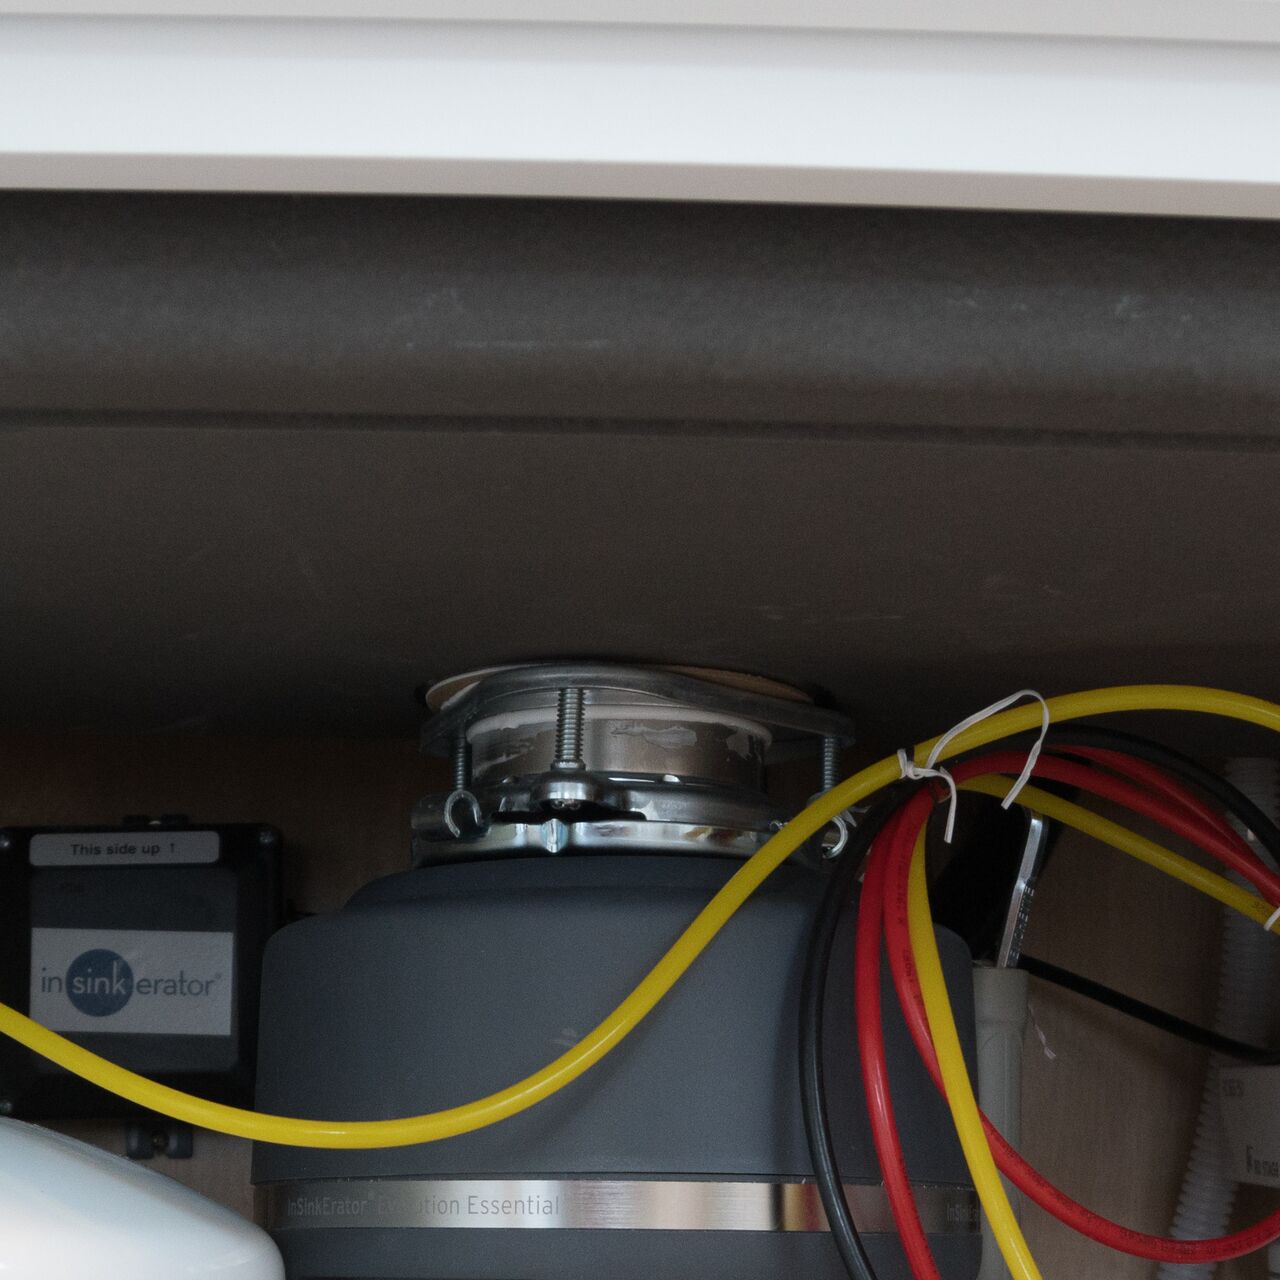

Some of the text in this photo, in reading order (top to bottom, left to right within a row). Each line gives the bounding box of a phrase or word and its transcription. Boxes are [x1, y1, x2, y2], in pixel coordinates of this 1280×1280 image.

[72, 842, 161, 857] This side up
[468, 1195, 560, 1216] Essential
